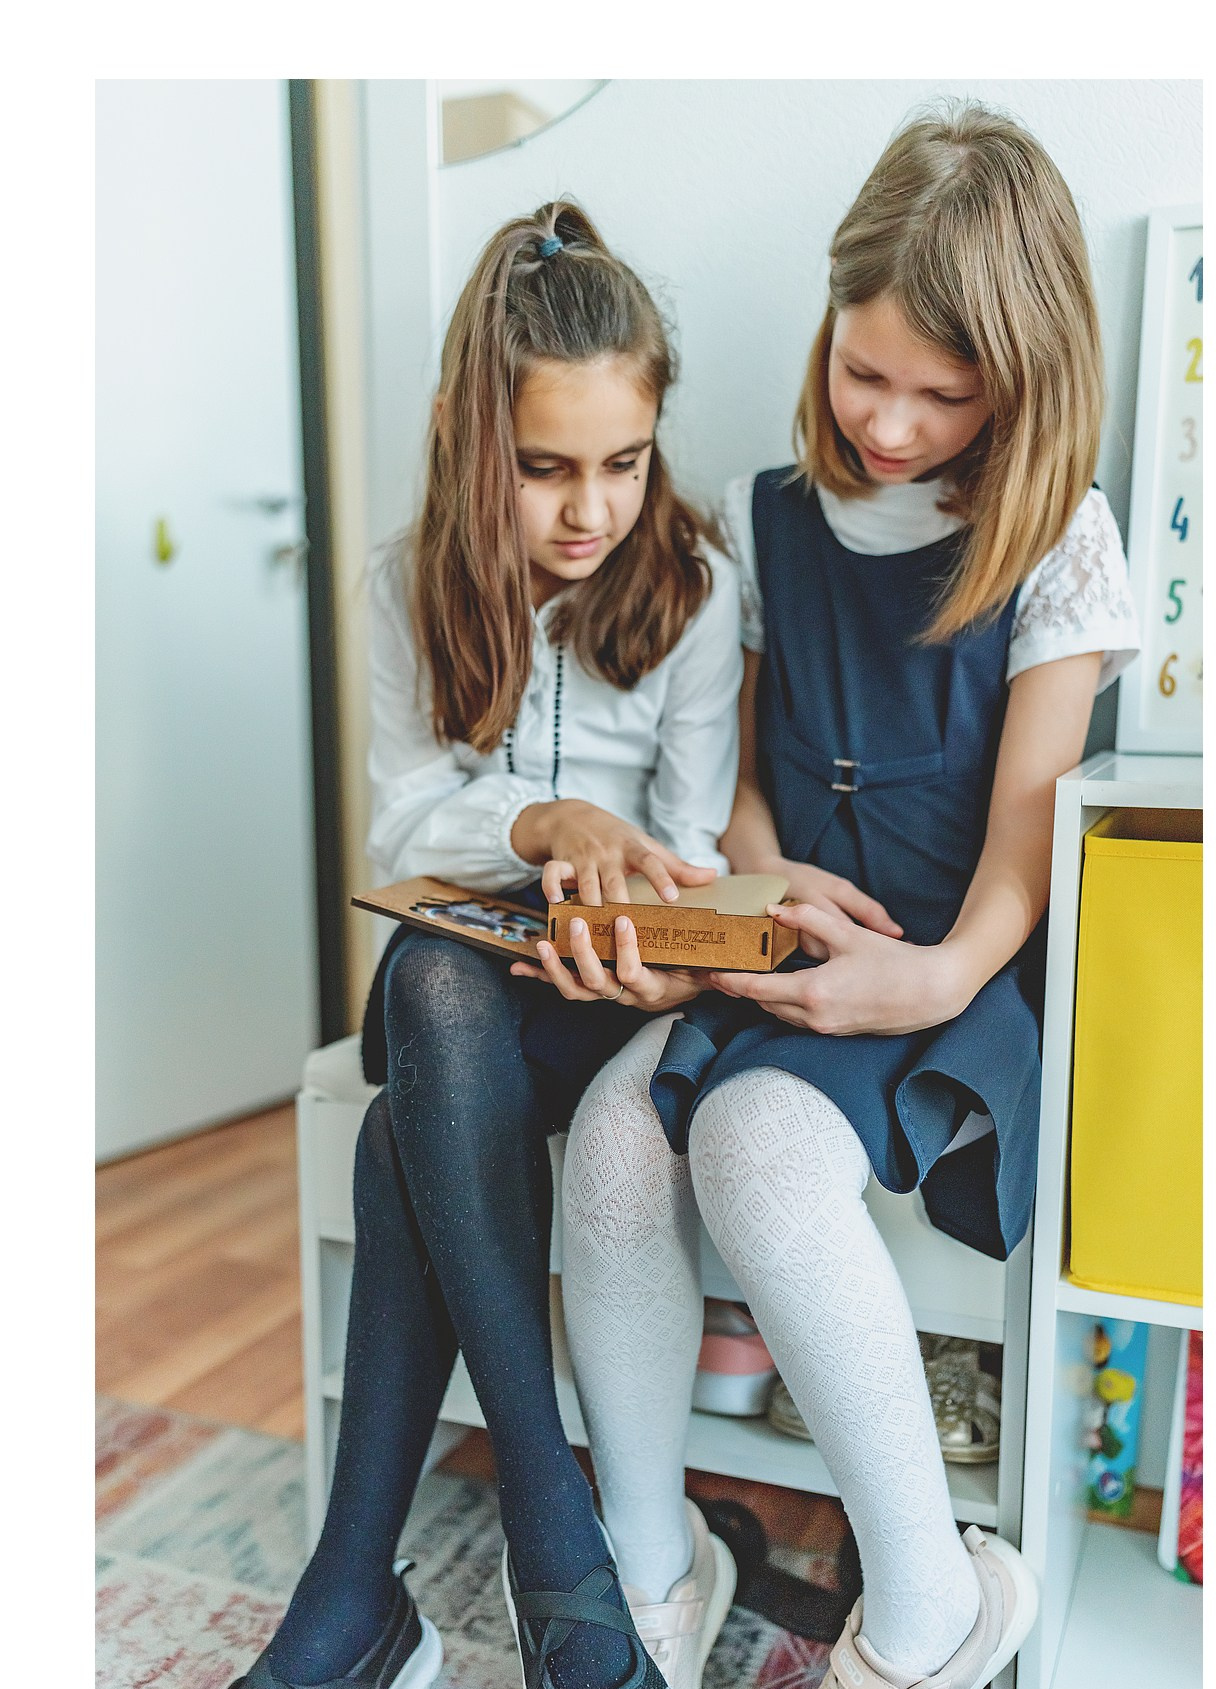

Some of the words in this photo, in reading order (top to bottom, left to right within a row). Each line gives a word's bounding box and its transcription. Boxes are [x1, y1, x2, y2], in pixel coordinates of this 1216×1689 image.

[1189, 256, 1203, 302] 1
[1185, 338, 1203, 384] 2
[1178, 416, 1198, 463] 3
[1170, 496, 1189, 543] 4
[1165, 578, 1187, 625] 5
[1158, 653, 1179, 698] 6
[592, 923, 669, 941] EXSIVE
[672, 928, 726, 945] PUZZLE
[642, 941, 697, 951] COLLECTION
